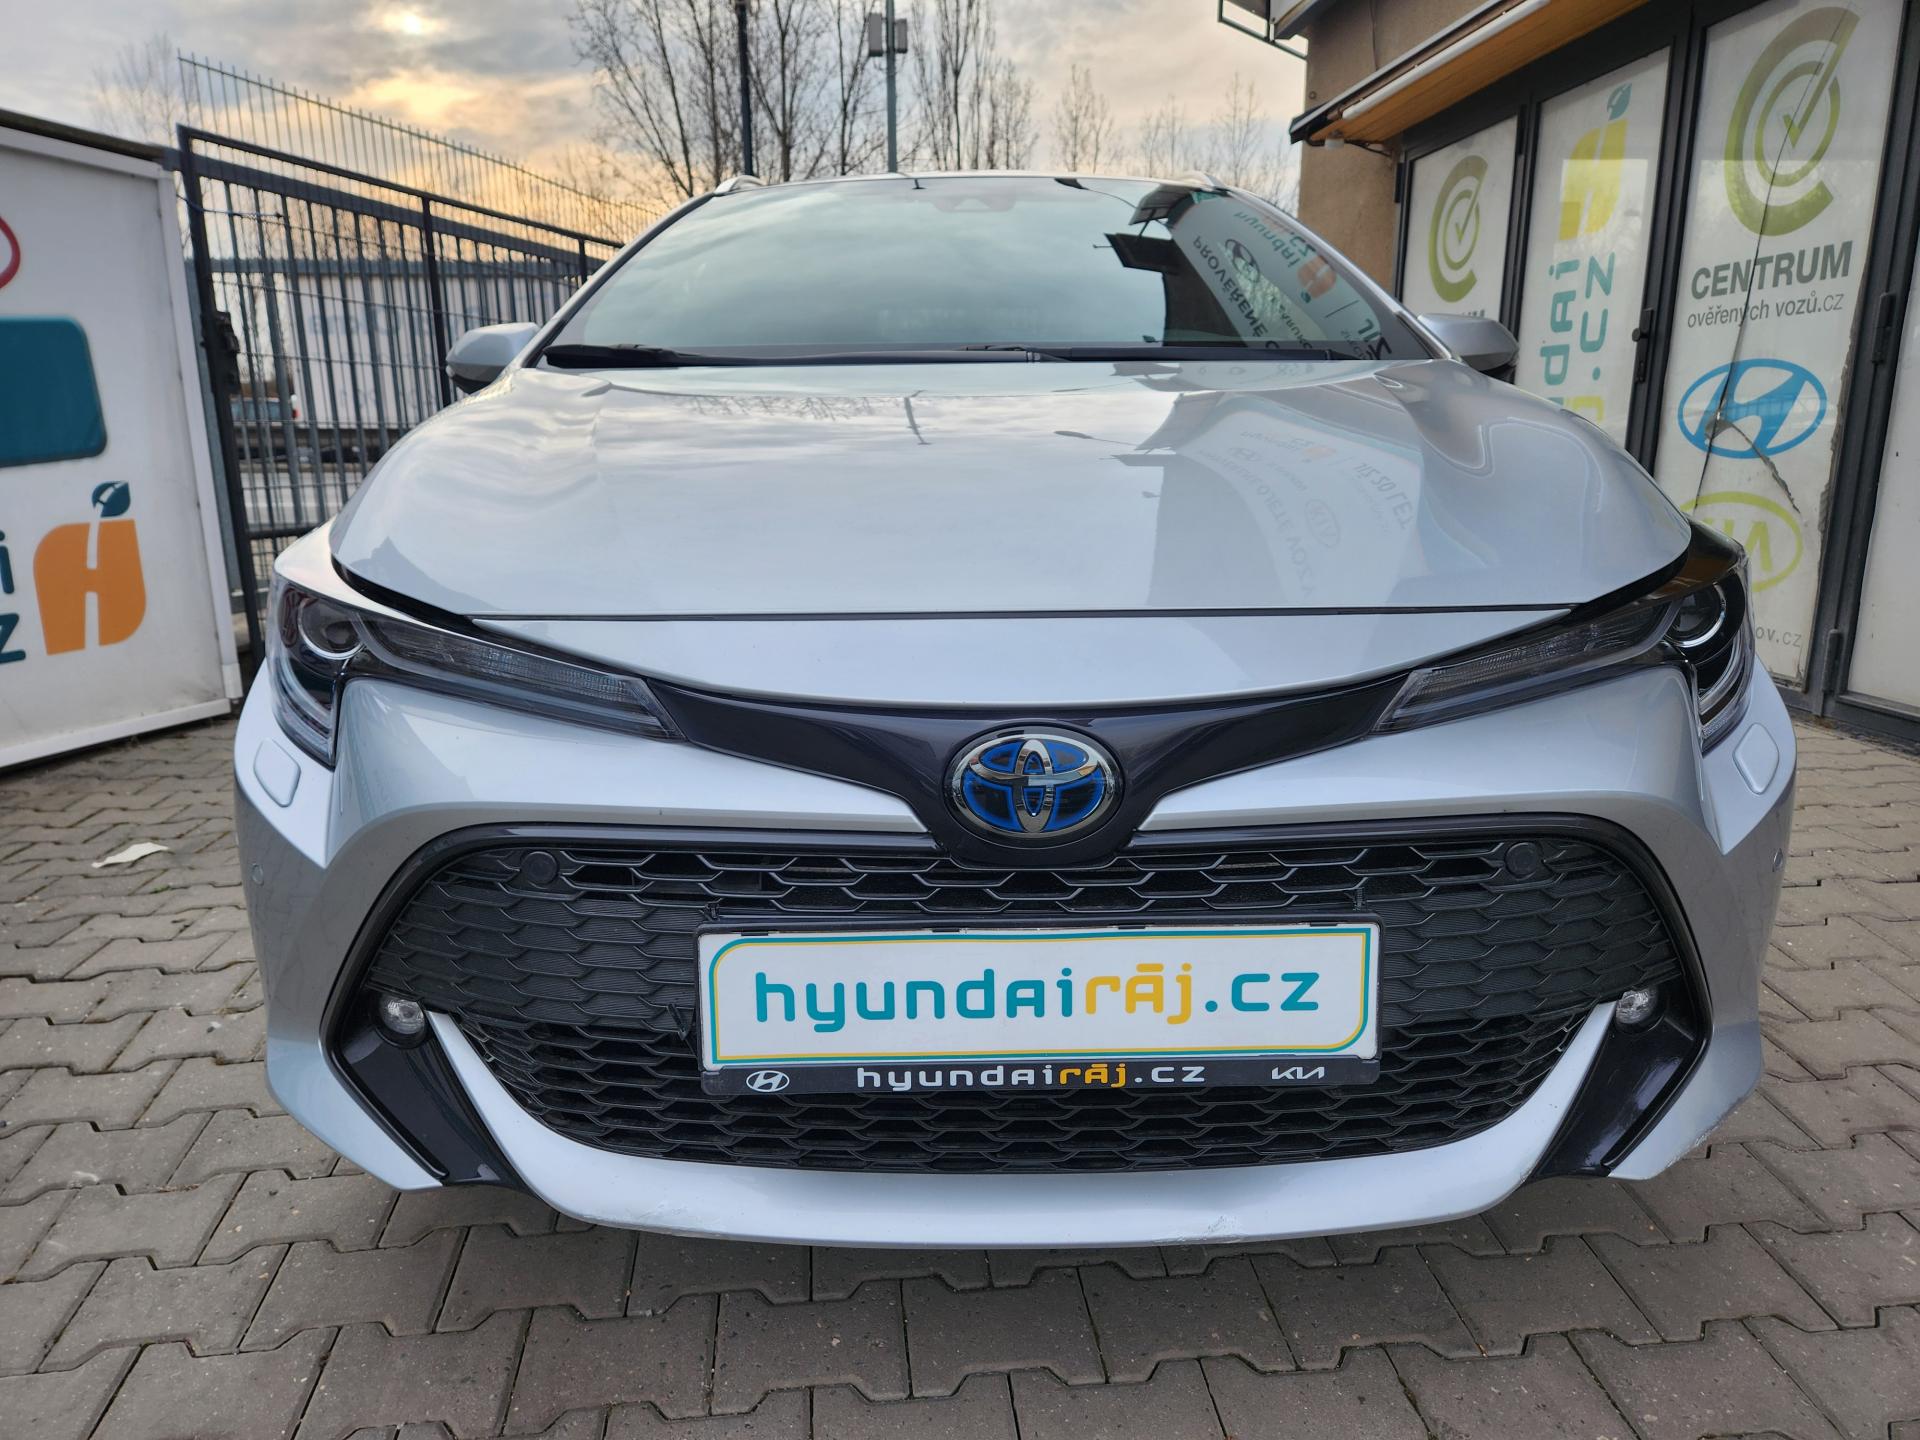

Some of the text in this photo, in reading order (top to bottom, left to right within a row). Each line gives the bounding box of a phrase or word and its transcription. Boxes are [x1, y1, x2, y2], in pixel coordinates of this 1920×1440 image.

[1691, 240, 1853, 300] CENTRUM
[1687, 290, 1844, 329] ověřených vozů.cz
